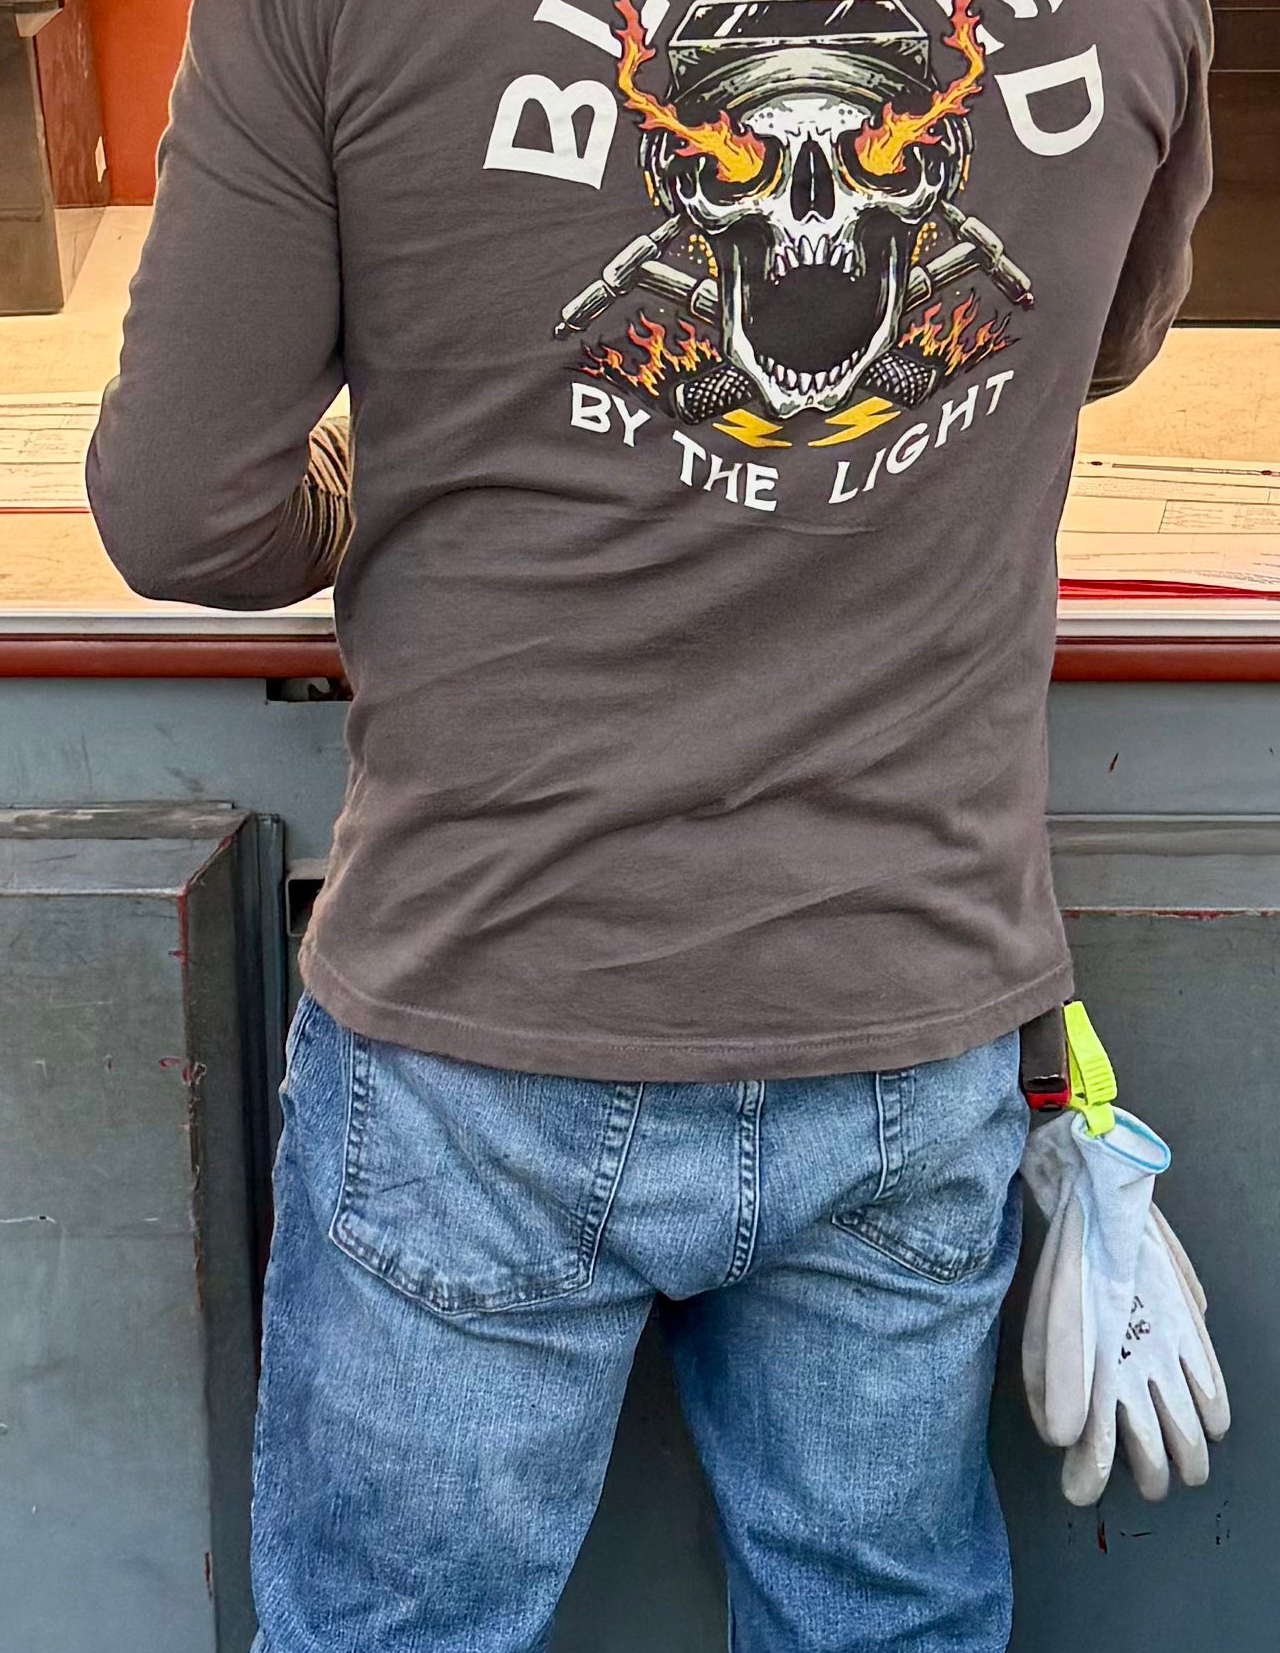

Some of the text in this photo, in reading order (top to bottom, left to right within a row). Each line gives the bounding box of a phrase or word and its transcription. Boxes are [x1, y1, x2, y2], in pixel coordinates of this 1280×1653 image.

[569, 382, 653, 446] BY
[672, 368, 1016, 512] THE LIGHT
